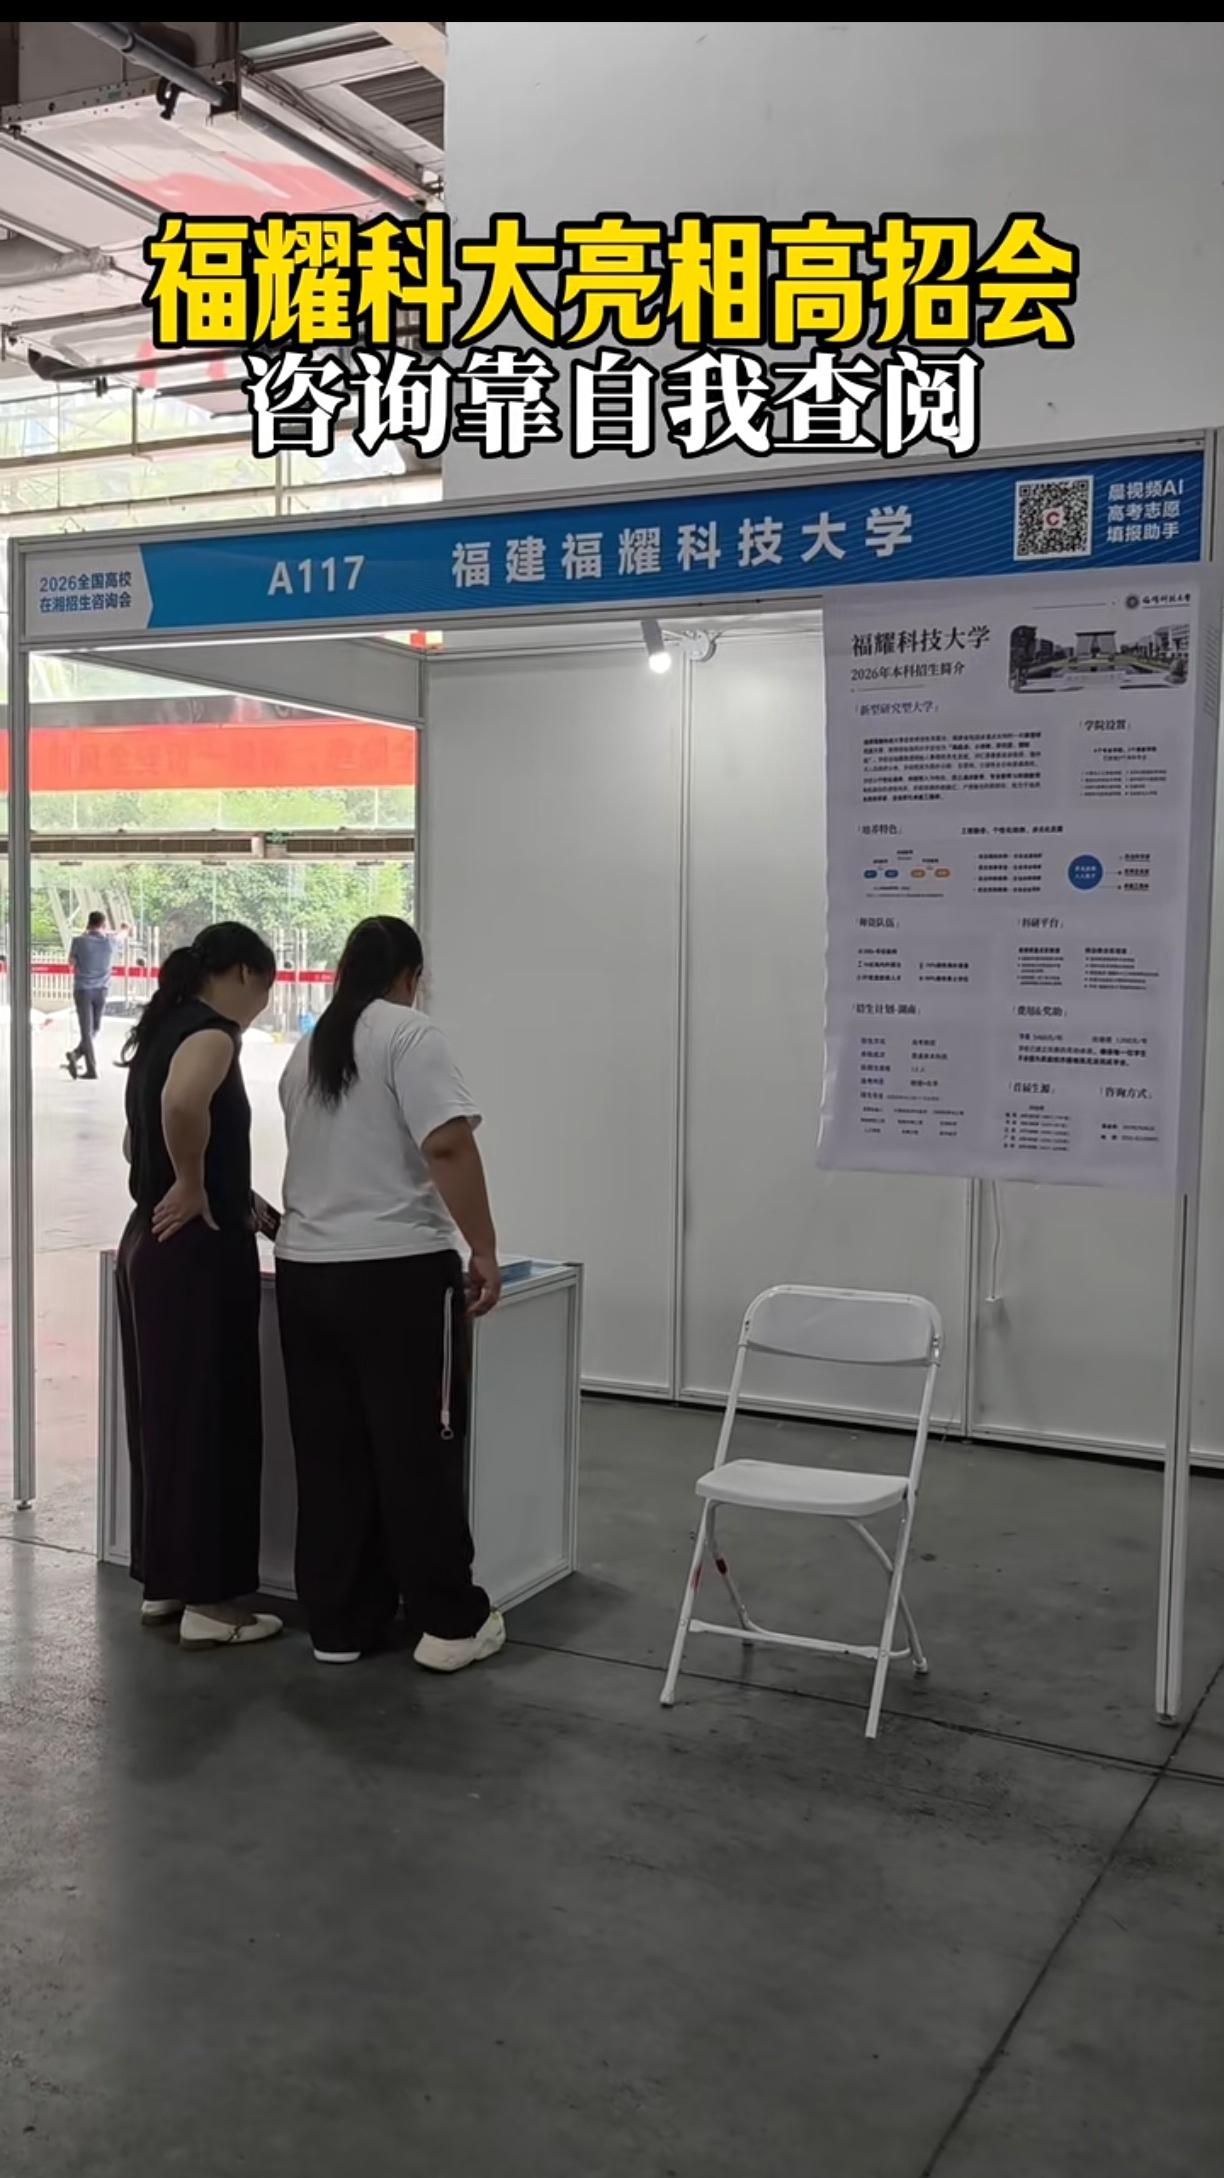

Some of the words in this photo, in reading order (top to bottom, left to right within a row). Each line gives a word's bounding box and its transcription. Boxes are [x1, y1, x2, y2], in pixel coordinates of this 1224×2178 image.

[1108, 479, 1184, 501] 晨视频AI
[1107, 501, 1181, 521] 高考志愿
[1107, 522, 1180, 543] 填报助手
[451, 506, 913, 588] 福建福耀科技大学
[39, 571, 133, 593] 2026全国高校
[267, 555, 366, 595] A117
[39, 592, 132, 614] 在湘招生咨询会
[851, 625, 991, 657] 福耀科技大学
[850, 663, 965, 682] 2026年本科招生简介
